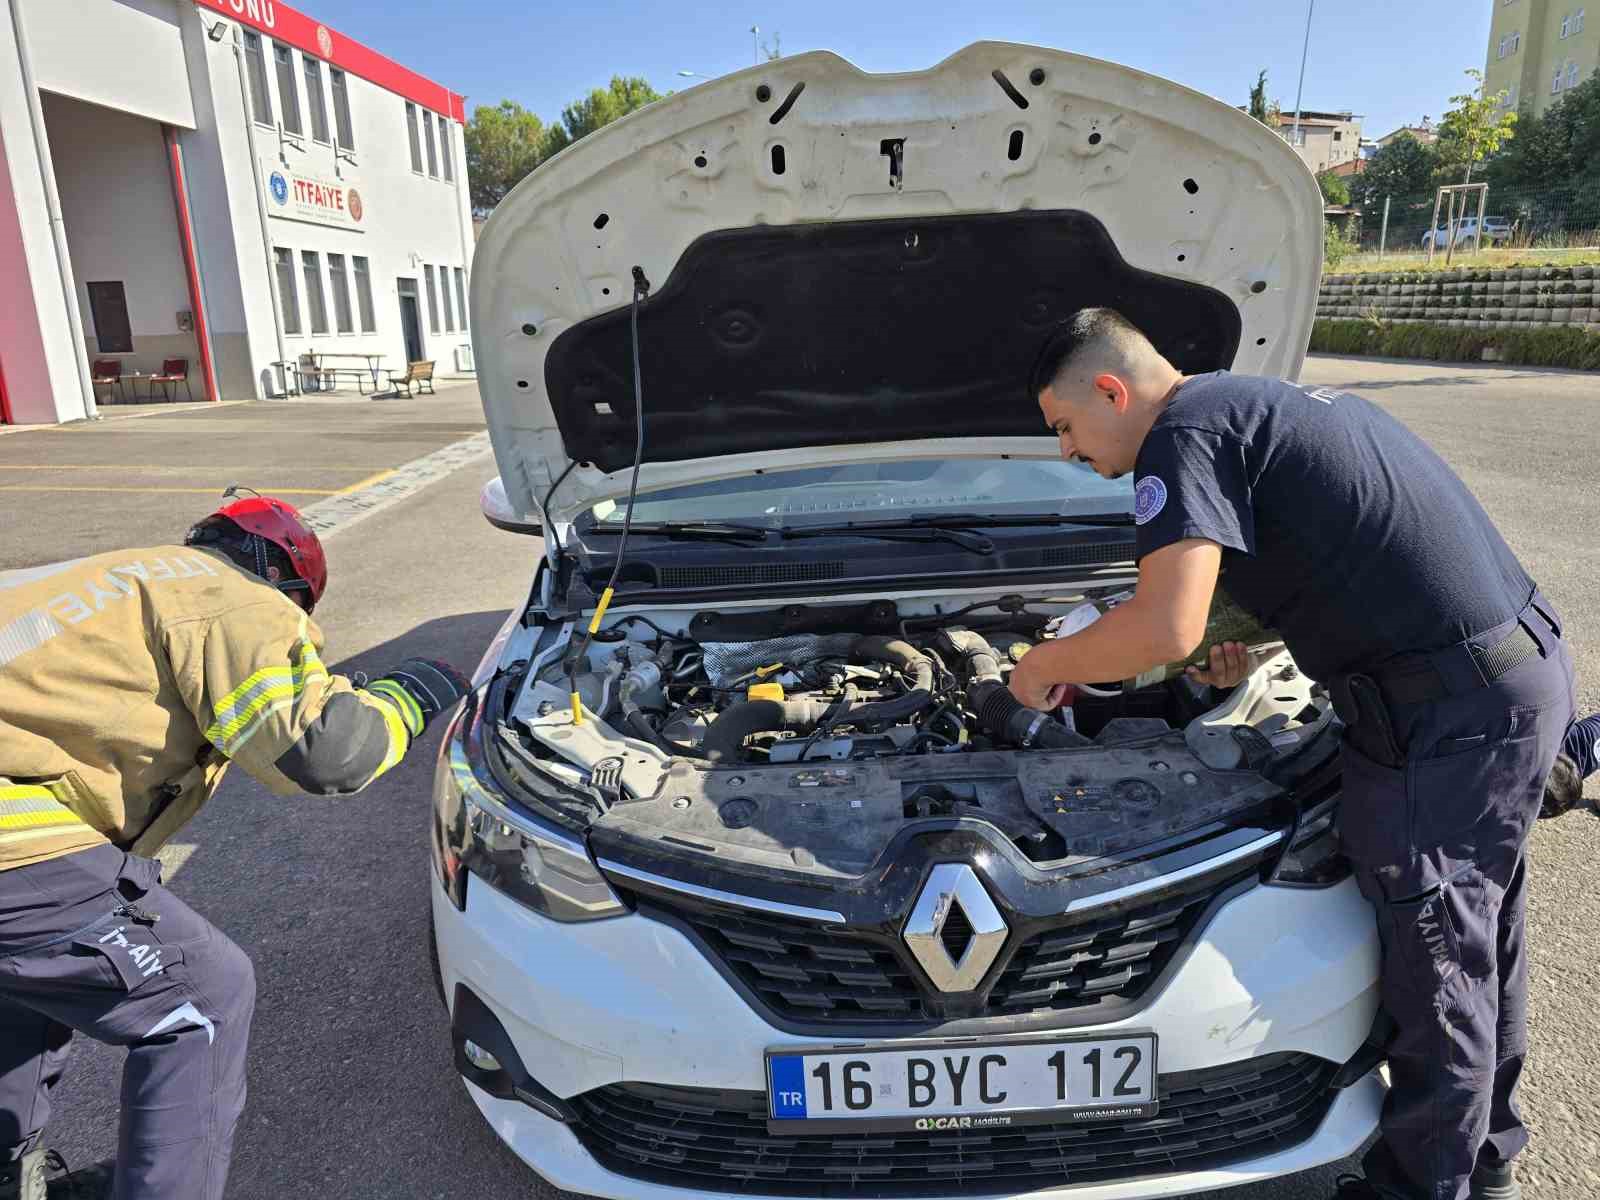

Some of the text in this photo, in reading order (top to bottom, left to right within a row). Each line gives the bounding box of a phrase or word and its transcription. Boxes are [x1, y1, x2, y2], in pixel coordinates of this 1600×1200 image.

[217, 0, 275, 29] ONU
[98, 926, 164, 977] İTAİY
[812, 1045, 1142, 1111] 16 BYC 112
[779, 1091, 803, 1106] TR
